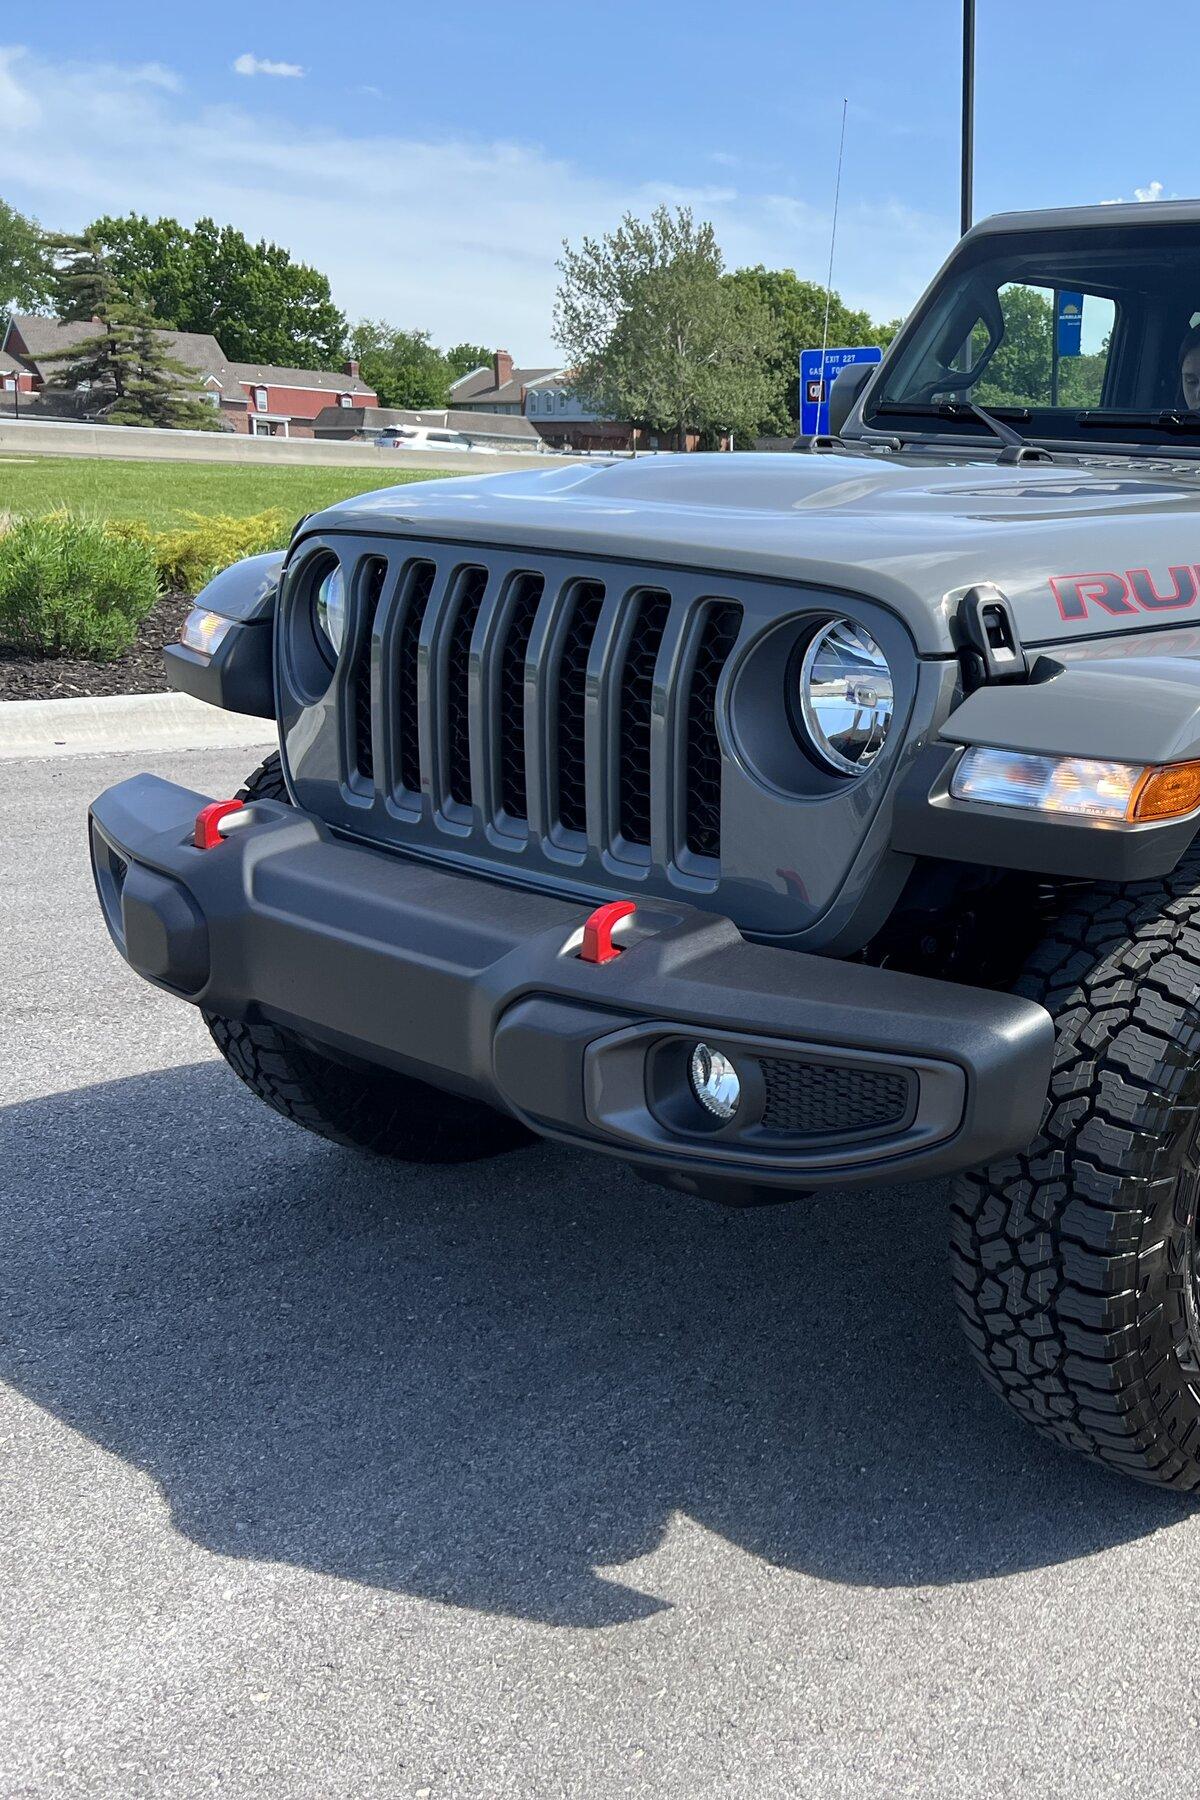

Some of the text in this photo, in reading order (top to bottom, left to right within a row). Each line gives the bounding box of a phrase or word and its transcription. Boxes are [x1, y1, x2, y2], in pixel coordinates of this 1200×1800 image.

[825, 354, 856, 363] EXIT 227
[809, 367, 823, 375] GAS
